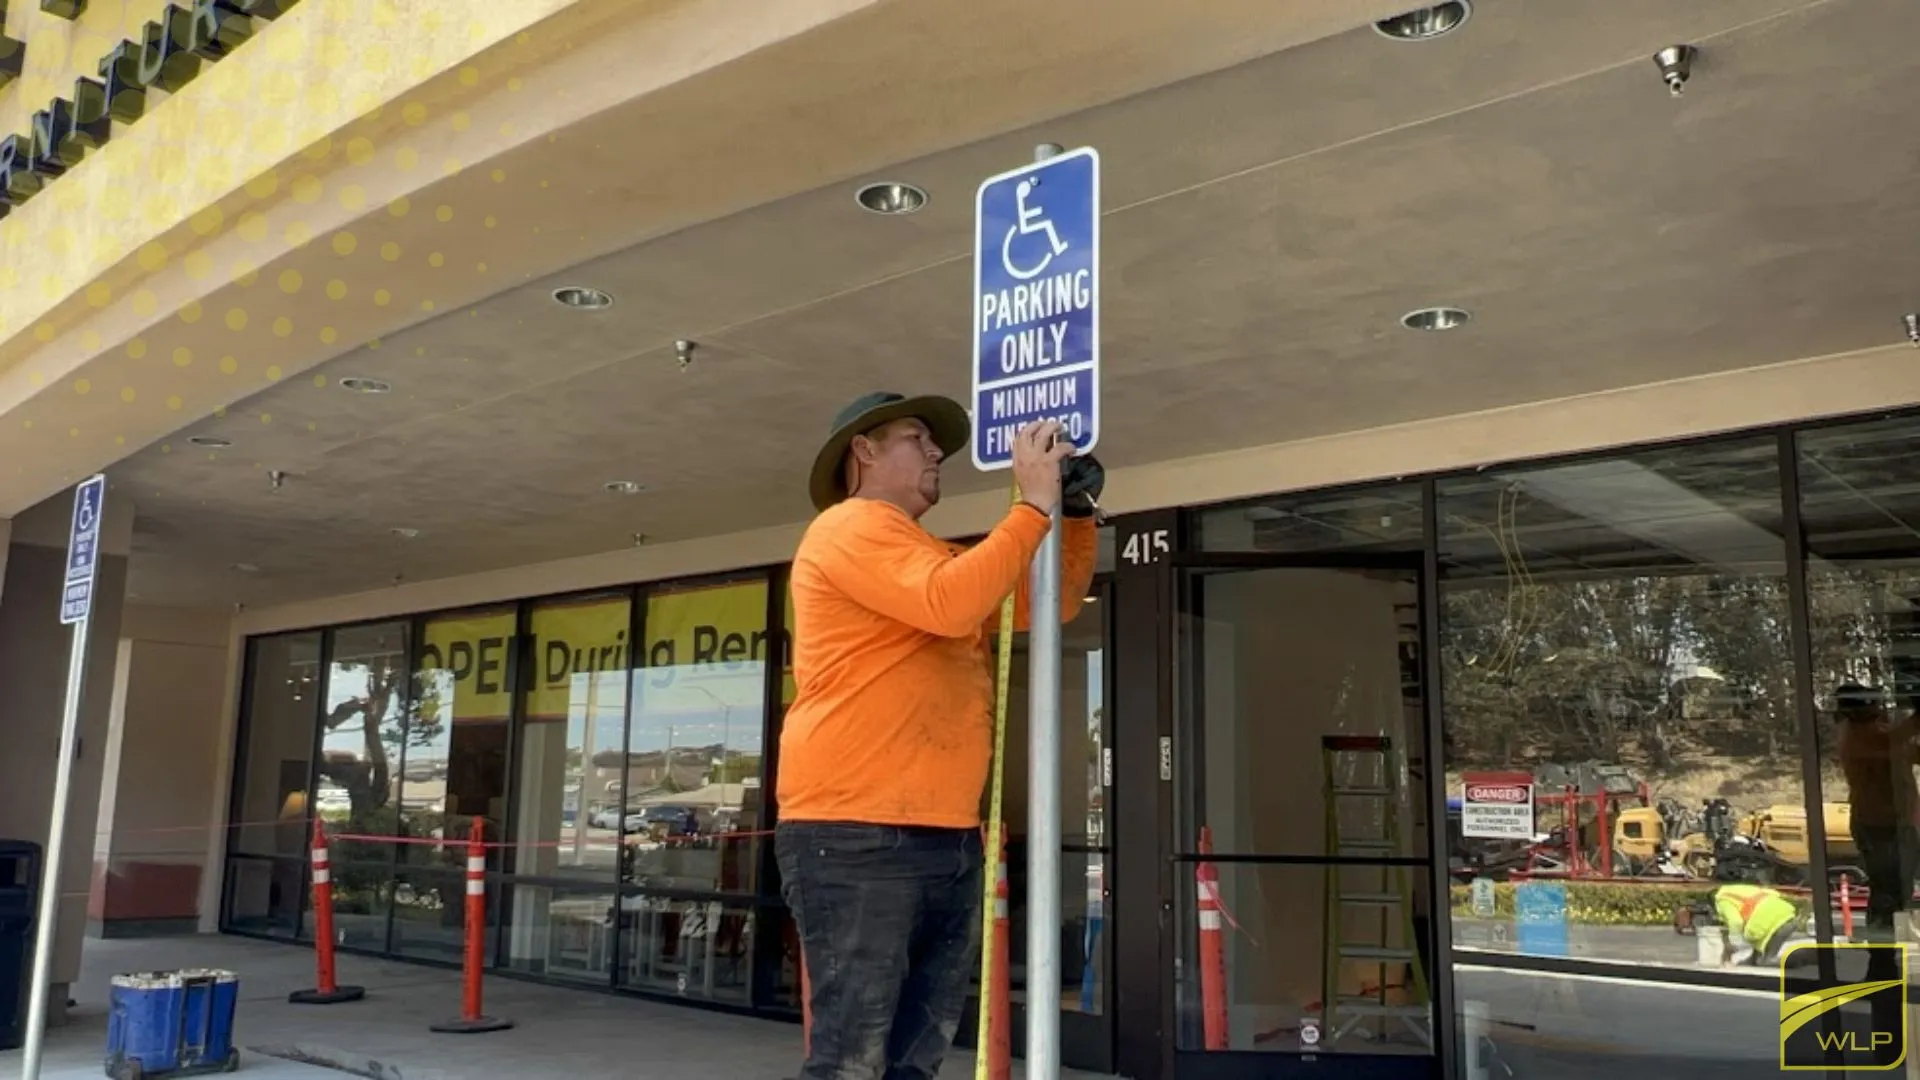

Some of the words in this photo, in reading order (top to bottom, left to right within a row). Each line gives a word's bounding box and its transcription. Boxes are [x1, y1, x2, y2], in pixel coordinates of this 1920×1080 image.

[982, 269, 1090, 332] PARKING
[1000, 321, 1069, 374] ONLY
[992, 376, 1077, 420] MINIMUM
[1121, 529, 1170, 565] 415
[1474, 787, 1521, 800] DANGER
